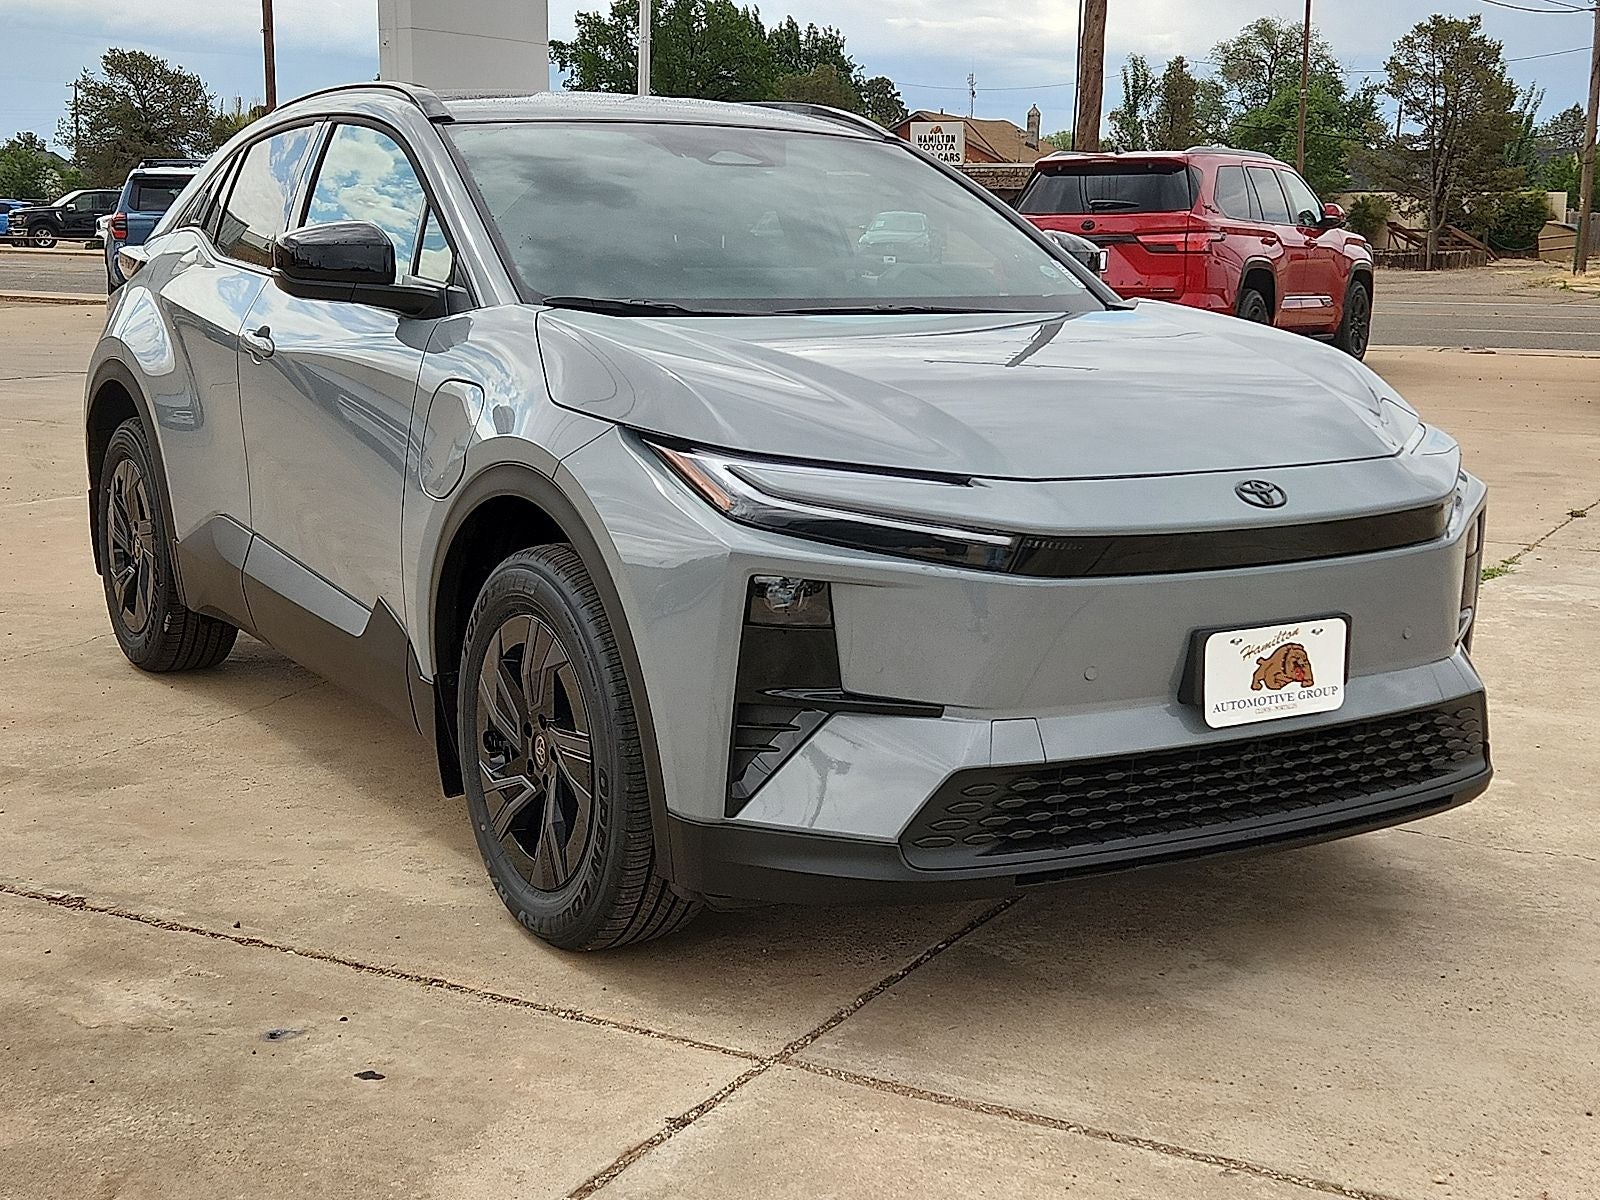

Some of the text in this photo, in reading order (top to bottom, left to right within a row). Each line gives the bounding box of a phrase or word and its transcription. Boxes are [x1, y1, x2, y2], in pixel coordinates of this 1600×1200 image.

[917, 134, 956, 143] HAMILTON
[918, 143, 955, 151] TOYOTA
[938, 152, 961, 162] CARS
[1240, 628, 1300, 661] Hamilton
[1212, 692, 1295, 714] AUTOMOTIVE
[1298, 685, 1339, 700] GROUP
[591, 766, 610, 878] OPEN
